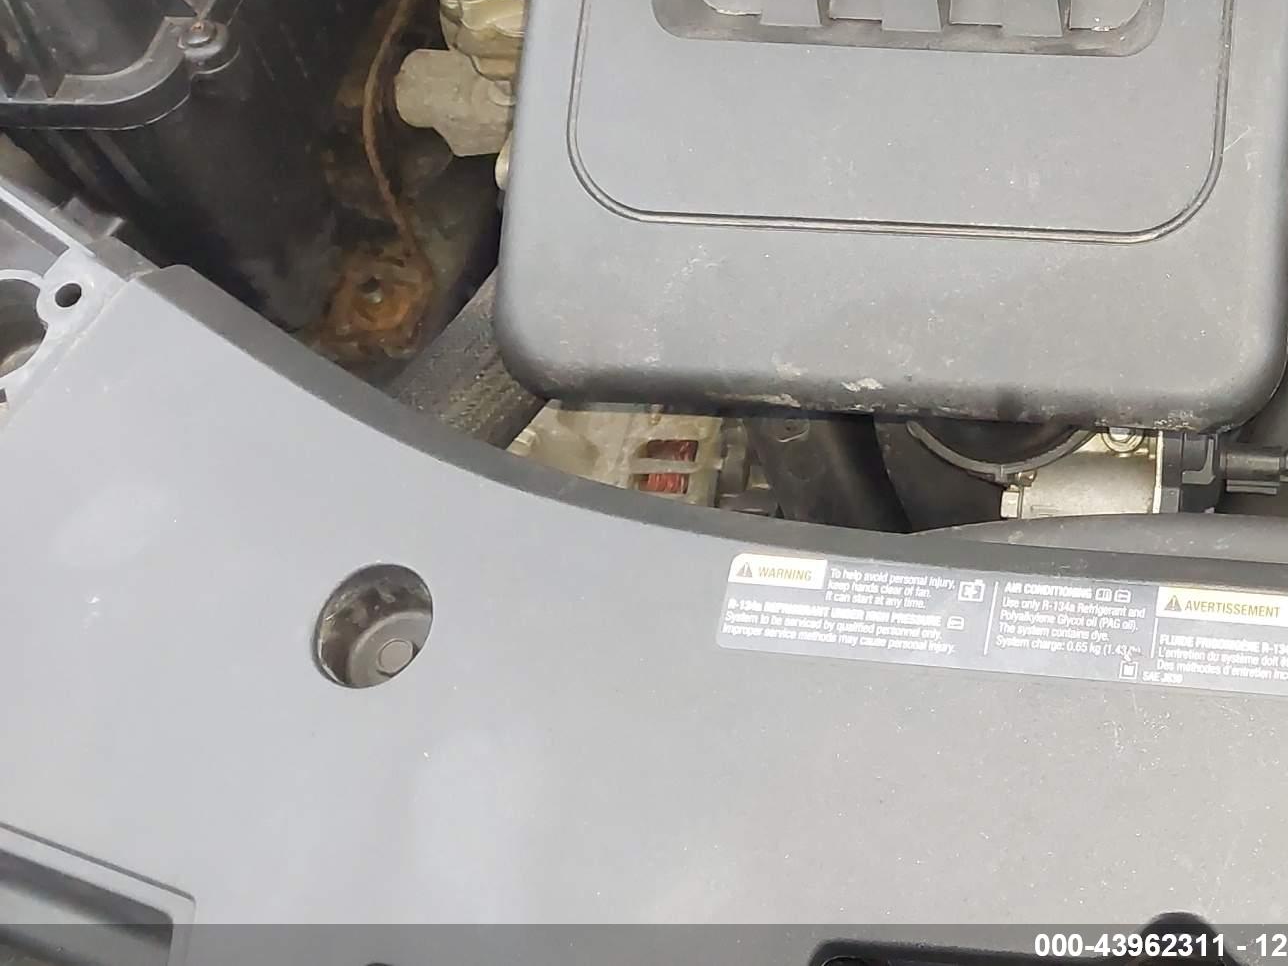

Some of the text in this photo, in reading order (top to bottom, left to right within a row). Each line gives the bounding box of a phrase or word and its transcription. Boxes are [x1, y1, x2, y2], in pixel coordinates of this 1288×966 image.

[758, 566, 811, 581] WARNING
[831, 568, 840, 578] To
[842, 569, 861, 581] help
[864, 570, 887, 582] avoid
[889, 573, 927, 587] personal
[851, 582, 877, 593] hands
[880, 584, 902, 595] clear
[904, 585, 912, 596] of
[915, 587, 930, 598] fan.
[1004, 582, 1091, 599] AIR CONDITIONING
[833, 592, 849, 602] can
[852, 593, 872, 604] start
[874, 595, 884, 605] at
[885, 597, 901, 608] any
[1002, 597, 1145, 618] Use only R-134a Refrigerant and
[1184, 599, 1280, 618] AVERTISSEMENT
[760, 615, 768, 624] to
[771, 616, 782, 625] be
[823, 620, 835, 631] by
[999, 622, 1014, 633] The
[1017, 624, 1048, 637] system
[1057, 614, 1084, 627] Glycol
[1098, 617, 1119, 629] (PAG
[764, 628, 796, 639] service
[798, 630, 836, 642] methods
[838, 634, 857, 646] may
[860, 636, 885, 646] cause
[887, 638, 926, 651] personal
[996, 635, 1028, 649] System
[1066, 640, 1087, 652] 0.65
[1089, 642, 1100, 655] kg
[1207, 650, 1219, 662] du
[1157, 660, 1174, 671] Des
